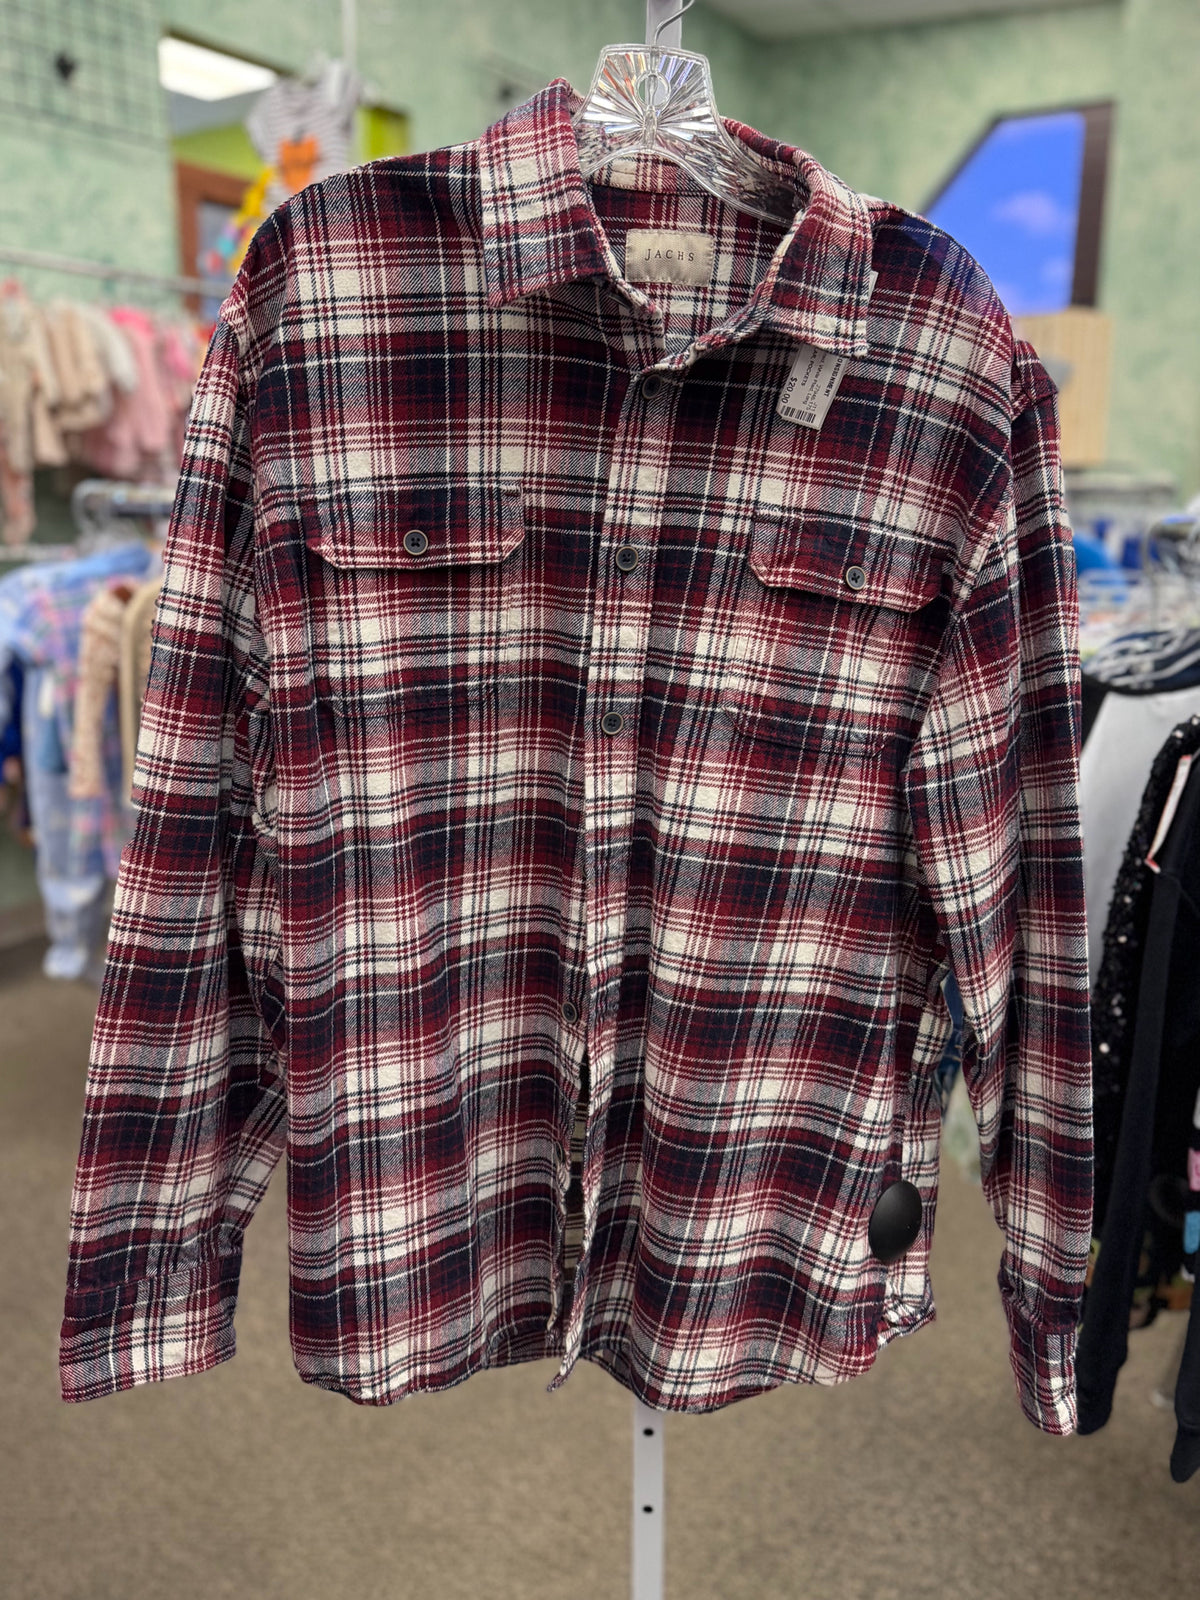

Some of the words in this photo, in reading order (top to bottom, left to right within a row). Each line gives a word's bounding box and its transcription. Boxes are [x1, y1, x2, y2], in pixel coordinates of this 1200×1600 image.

[645, 248, 694, 261] JACHS
[801, 360, 814, 386] POCKETS
[823, 358, 843, 397] ONSIGNMENT
[781, 376, 797, 404] $20.00
